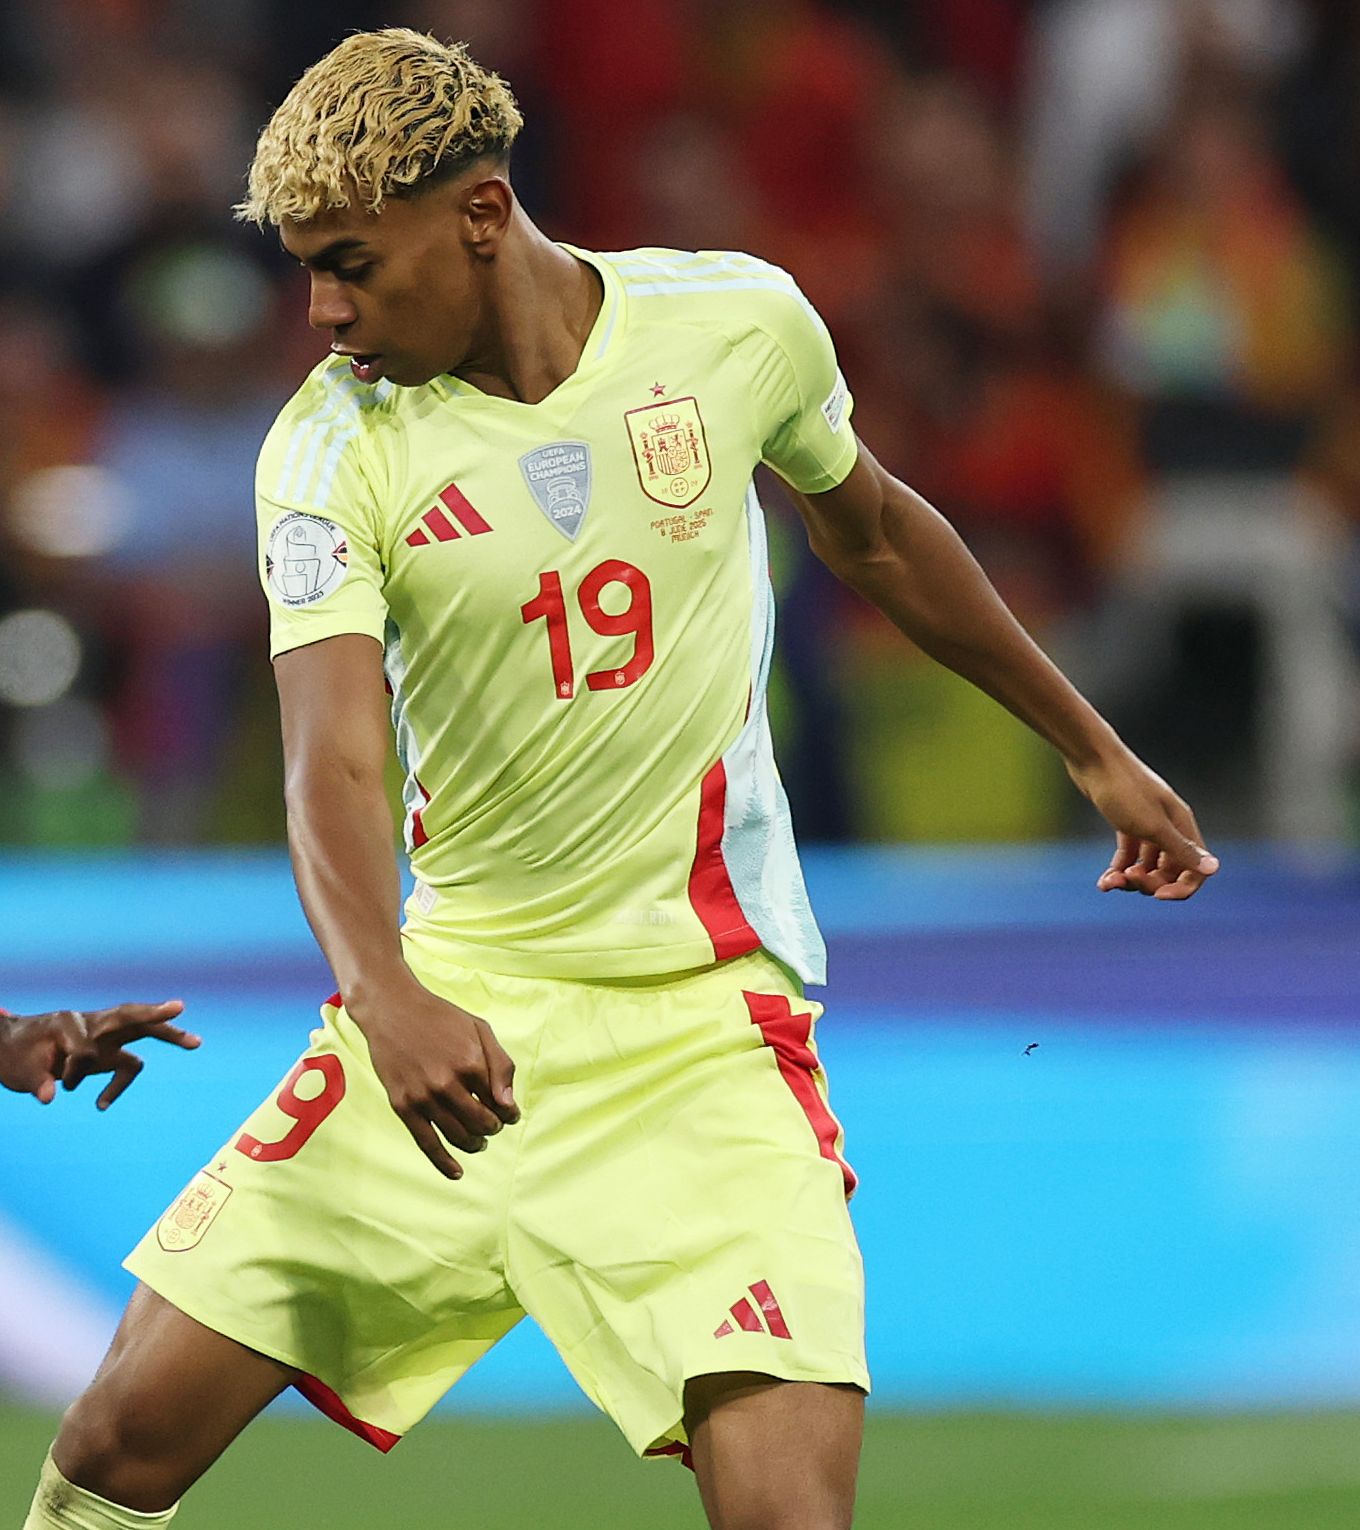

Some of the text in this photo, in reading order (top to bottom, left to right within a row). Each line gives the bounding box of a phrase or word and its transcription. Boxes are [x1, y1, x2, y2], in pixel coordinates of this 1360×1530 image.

[542, 447, 565, 457] UEFA
[527, 452, 585, 472] EUROPEAN
[530, 461, 586, 481] CHAMPIONS
[553, 504, 582, 519] 2024
[651, 515, 687, 530] PORTUGAL
[669, 524, 687, 535] JUNE
[671, 530, 700, 543] MUNICH
[520, 559, 655, 700] 19
